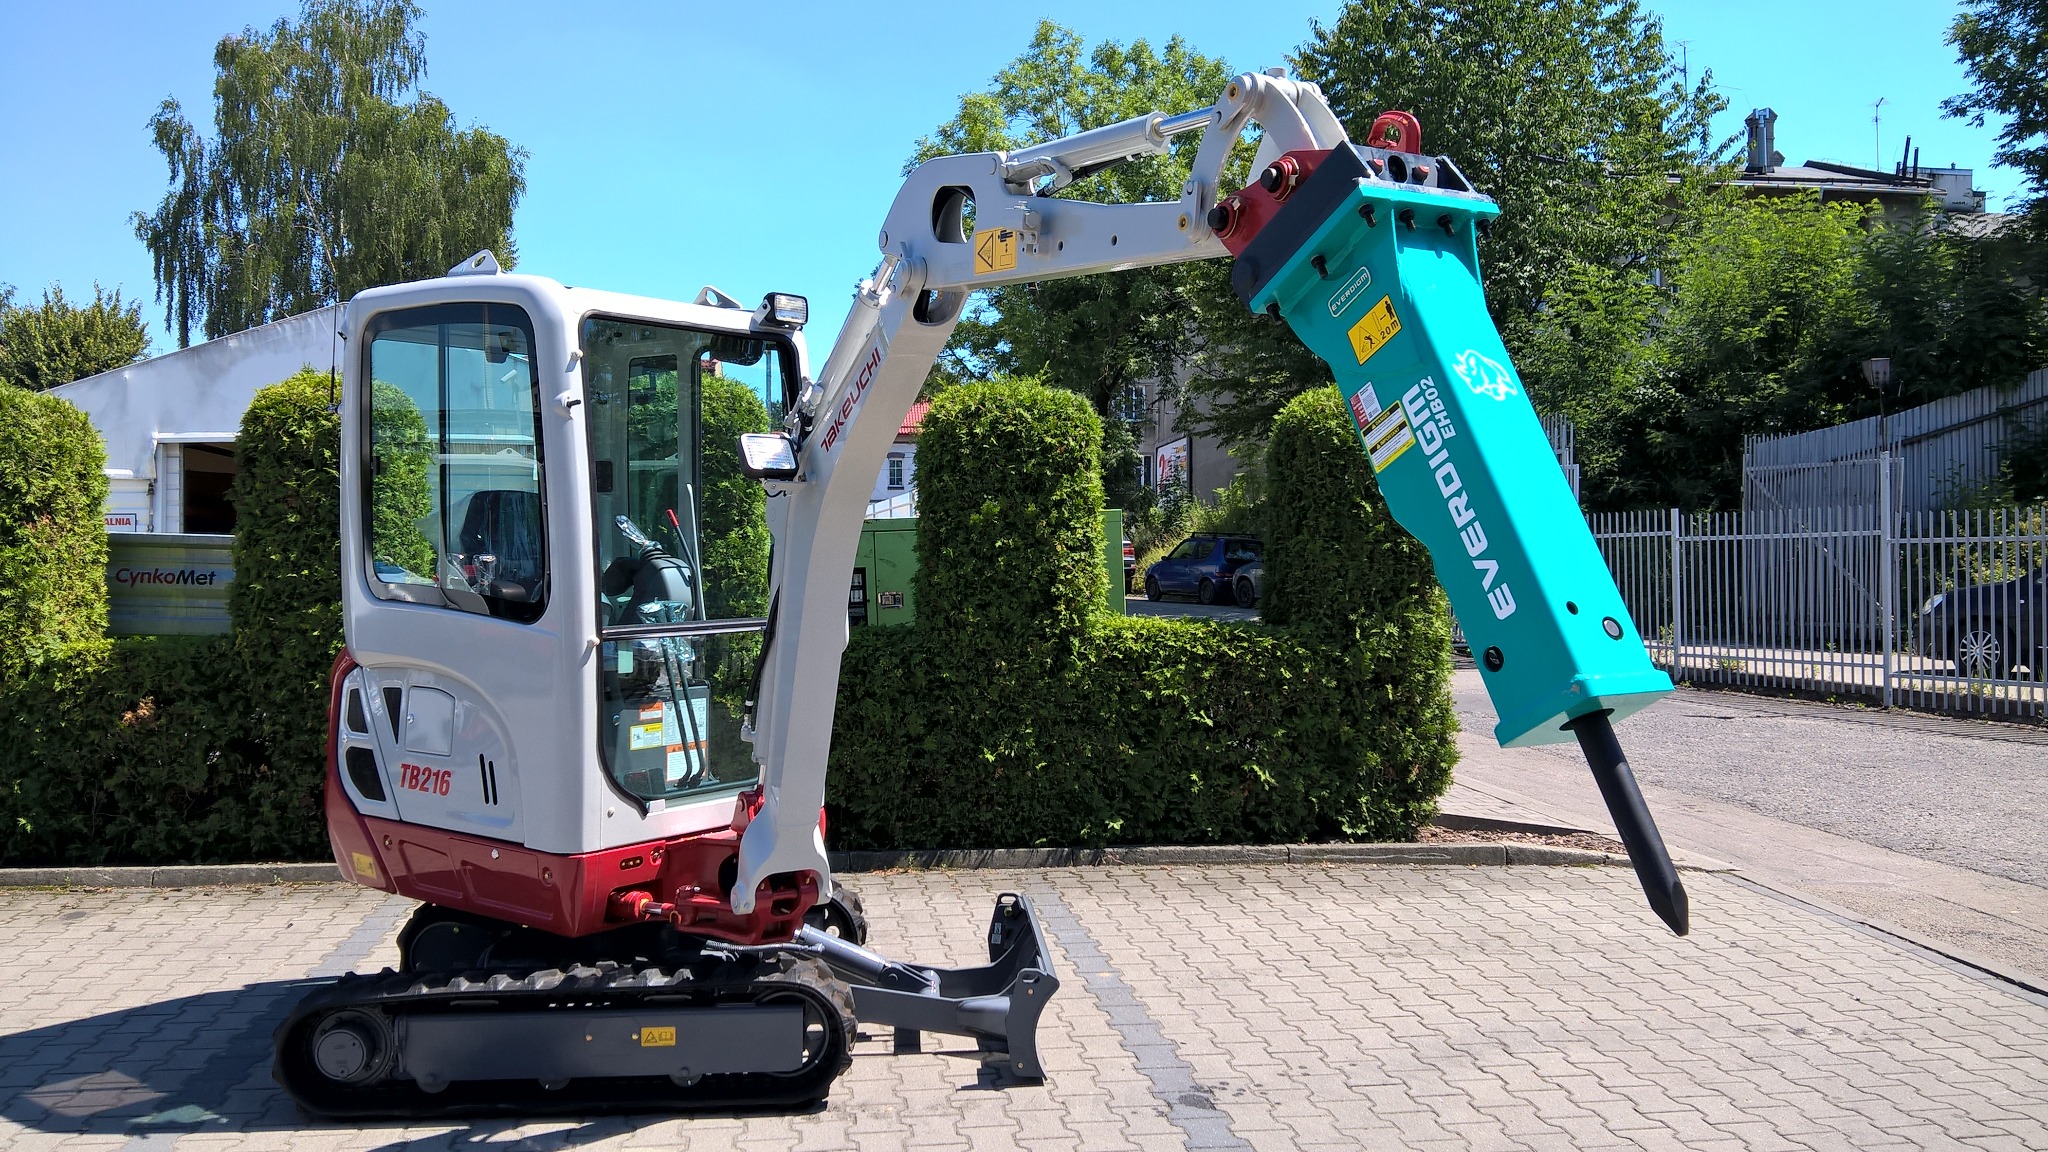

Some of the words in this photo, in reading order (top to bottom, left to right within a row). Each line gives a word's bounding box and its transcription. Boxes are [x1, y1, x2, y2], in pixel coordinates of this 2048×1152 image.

[1420, 375, 1457, 439] EHB02
[115, 567, 217, 588] CynkoMet
[400, 763, 452, 797] TB216
